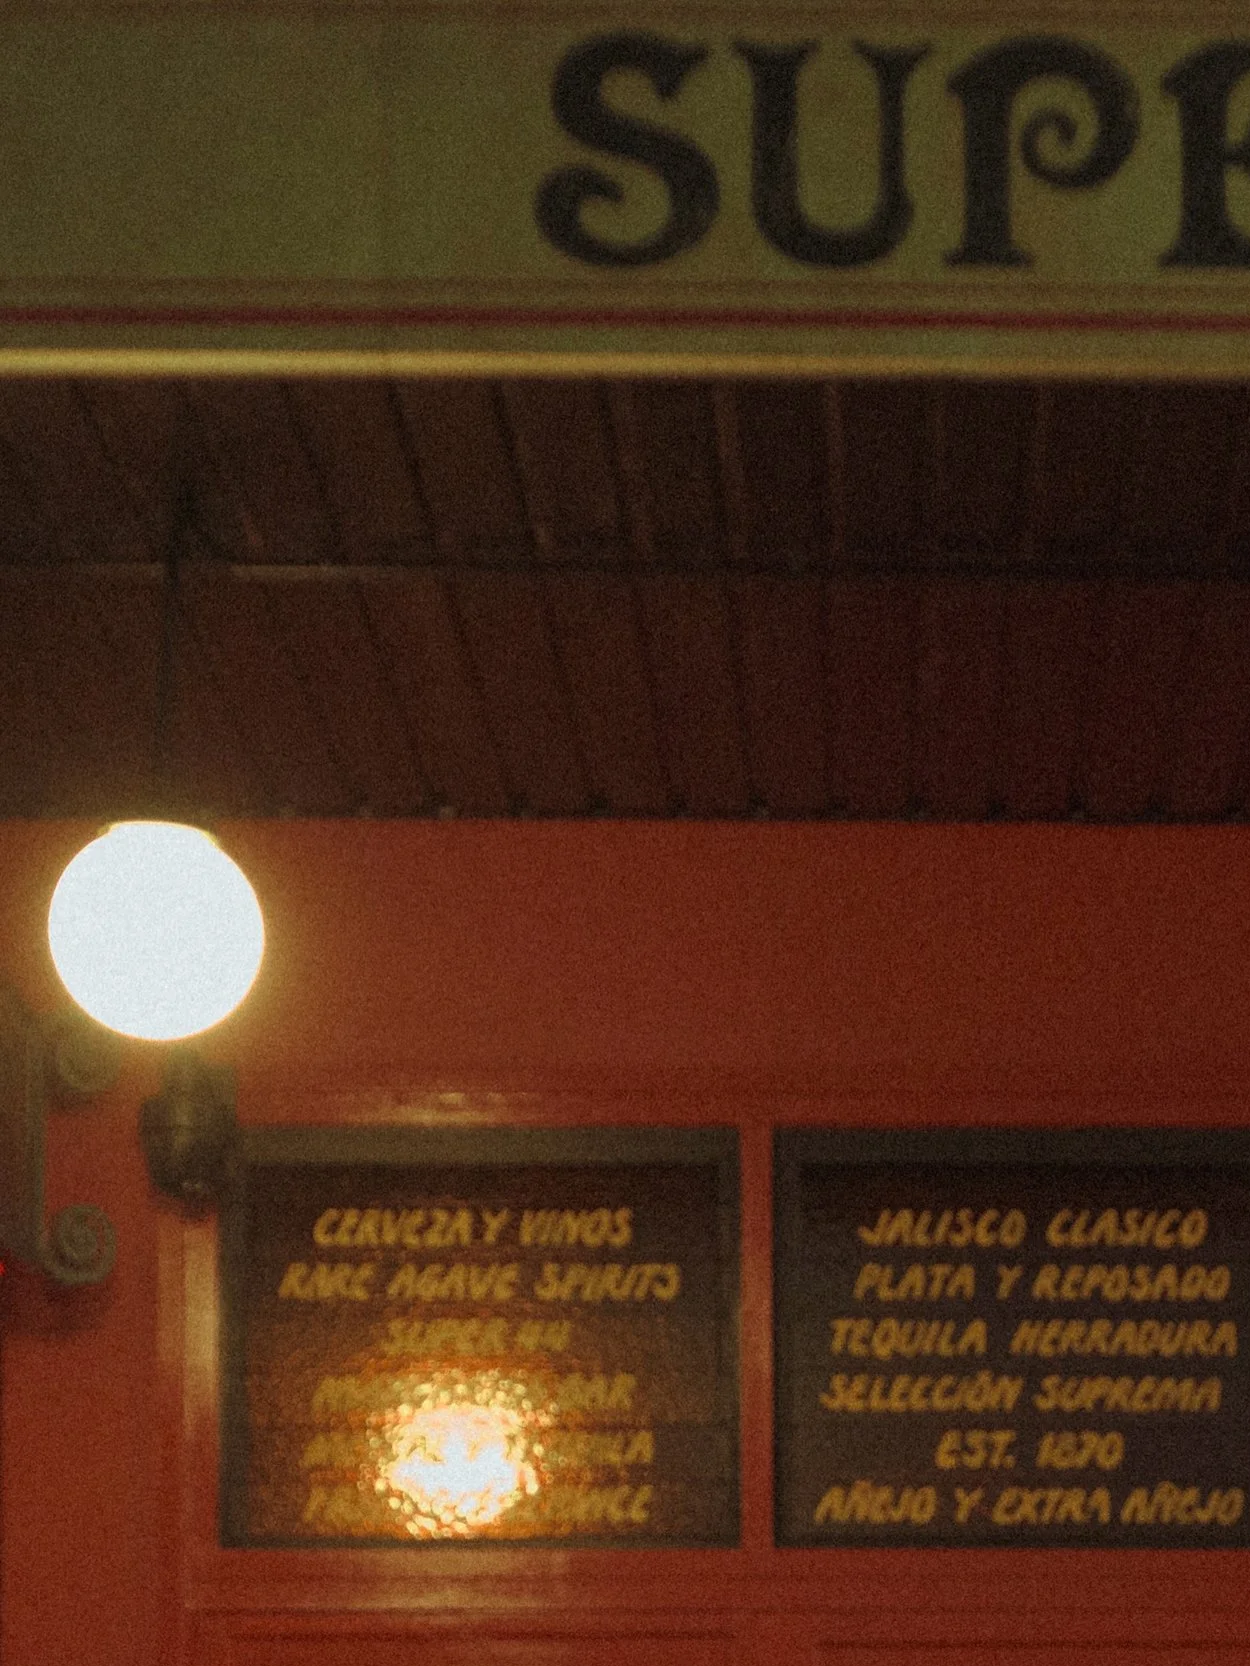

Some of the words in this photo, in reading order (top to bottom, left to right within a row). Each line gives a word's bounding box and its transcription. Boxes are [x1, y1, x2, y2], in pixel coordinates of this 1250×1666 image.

[312, 1207, 473, 1248] CERVEZA
[480, 1208, 510, 1246] Y
[519, 1207, 634, 1247] VINOS
[857, 1208, 1027, 1248] JALISCO
[1045, 1208, 1209, 1249] CLASICO
[277, 1262, 376, 1302] RARE
[387, 1262, 522, 1302] AGAVE
[534, 1262, 682, 1301] SPIRITS
[853, 1263, 976, 1302] PLATA
[996, 1263, 1024, 1301] Y
[1031, 1264, 1232, 1302] REPOSADO
[829, 1318, 988, 1361] TEQUILA
[1009, 1319, 1238, 1357] HERRADURA
[818, 1368, 1024, 1413] SELECCIÓN
[1033, 1375, 1223, 1414] SUPREMA
[935, 1429, 1017, 1470] EST.
[1036, 1430, 1126, 1470] 1870
[813, 1478, 938, 1525] AÑEJO
[952, 1486, 986, 1525] Y
[991, 1486, 1112, 1525] EXTRA
[1120, 1480, 1246, 1526] AÑEJO
